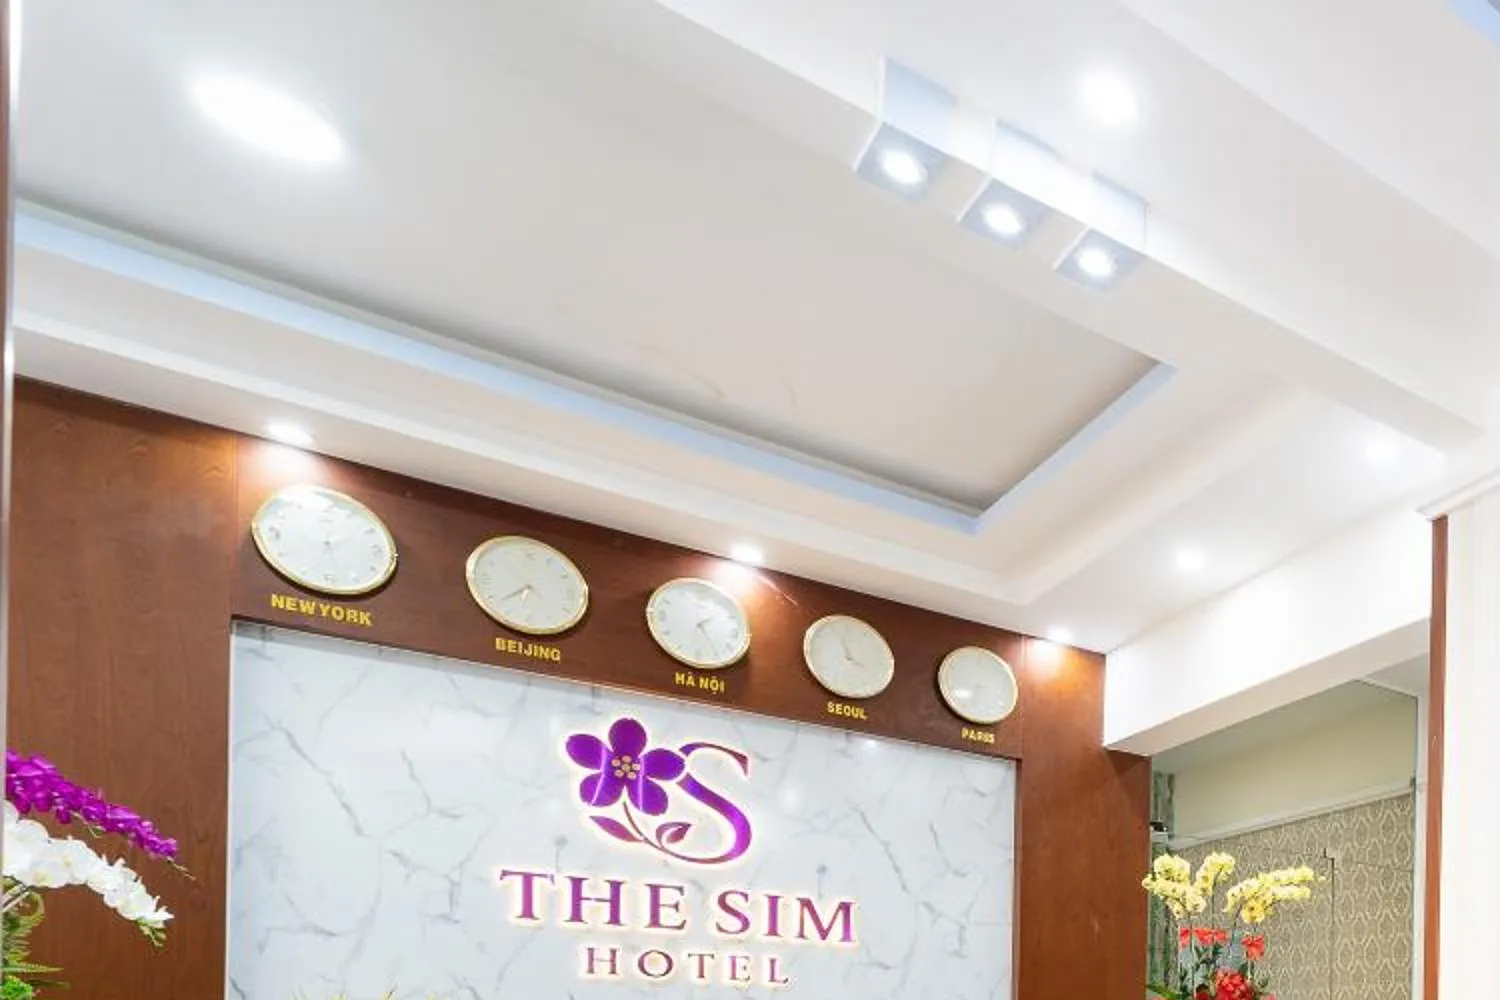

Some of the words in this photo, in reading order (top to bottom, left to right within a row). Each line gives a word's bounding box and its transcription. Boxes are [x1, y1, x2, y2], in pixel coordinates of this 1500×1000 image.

[494, 637, 562, 662] BEIJING
[675, 671, 696, 688] HÀ
[699, 676, 726, 695] NỘI
[826, 701, 868, 720] SEOUL
[499, 869, 687, 931] THE
[714, 889, 856, 943] SIM
[585, 947, 790, 984] HOTEL
